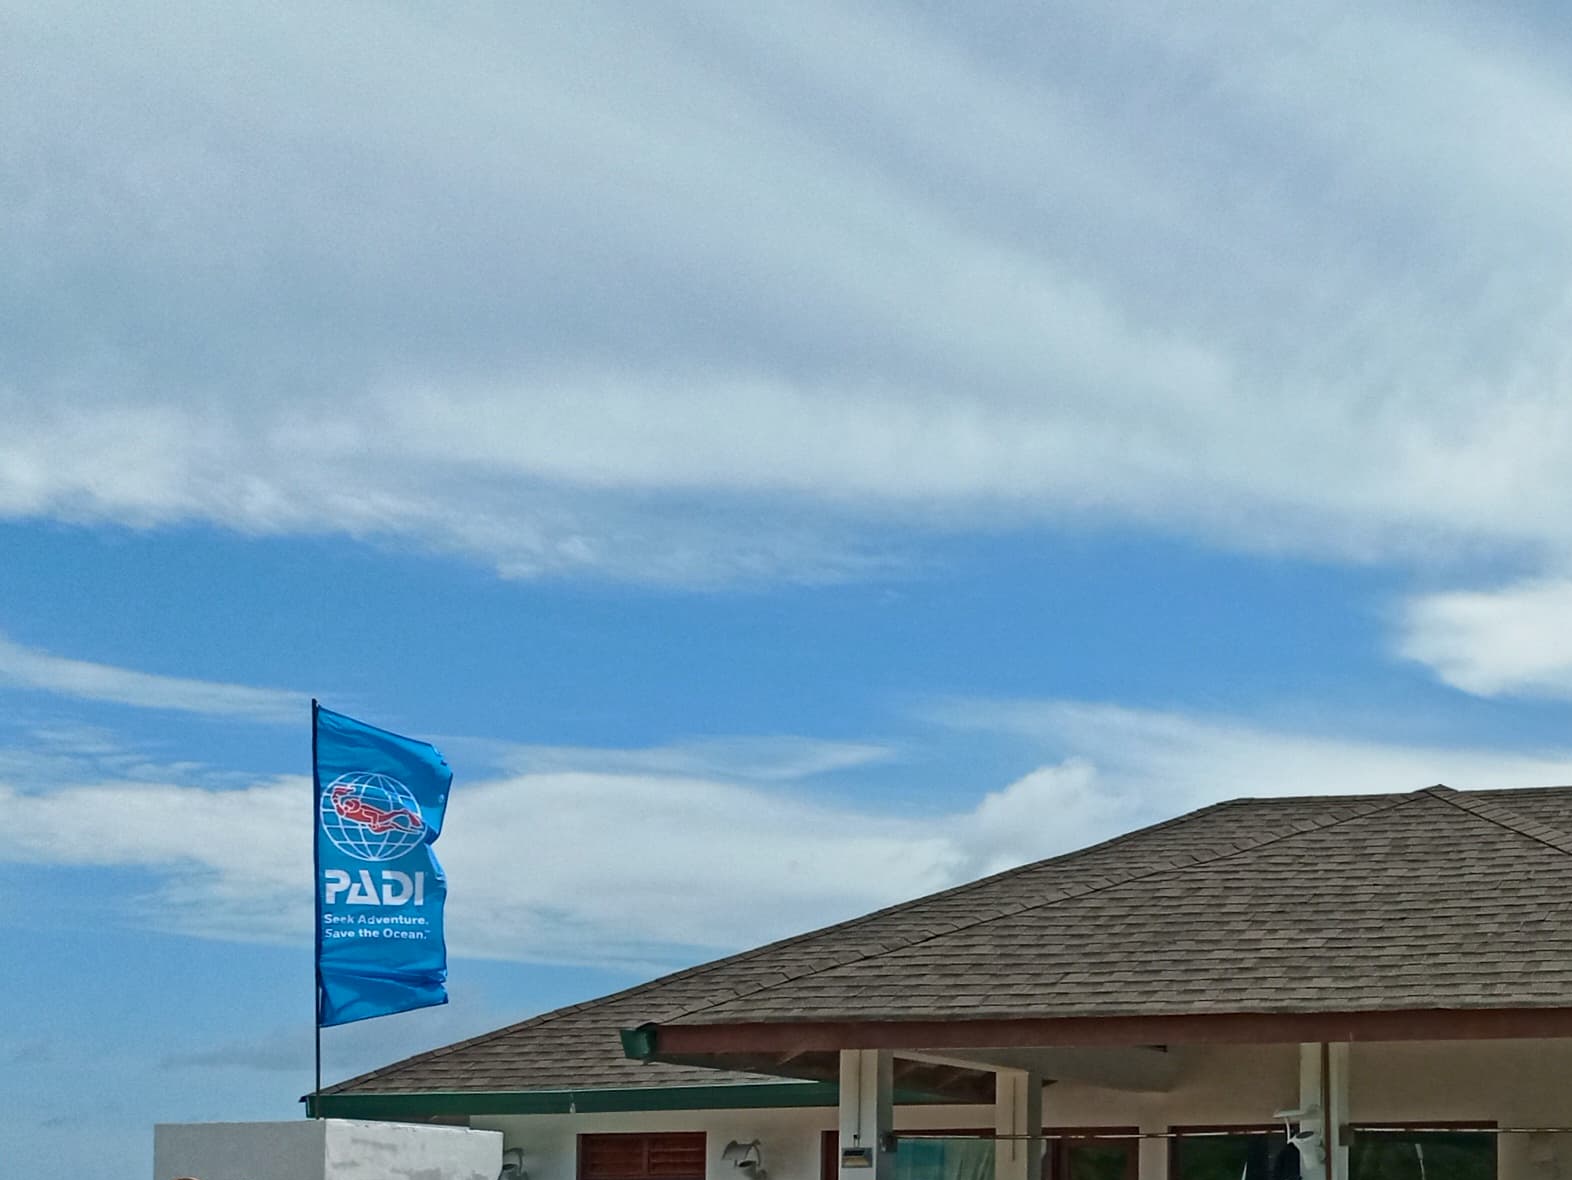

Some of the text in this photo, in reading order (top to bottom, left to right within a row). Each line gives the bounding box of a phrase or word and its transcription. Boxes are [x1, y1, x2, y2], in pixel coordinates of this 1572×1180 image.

[324, 869, 424, 906] PADI
[324, 914, 429, 925] Seek Adventure.
[325, 928, 356, 938] Save
[358, 928, 380, 938] the
